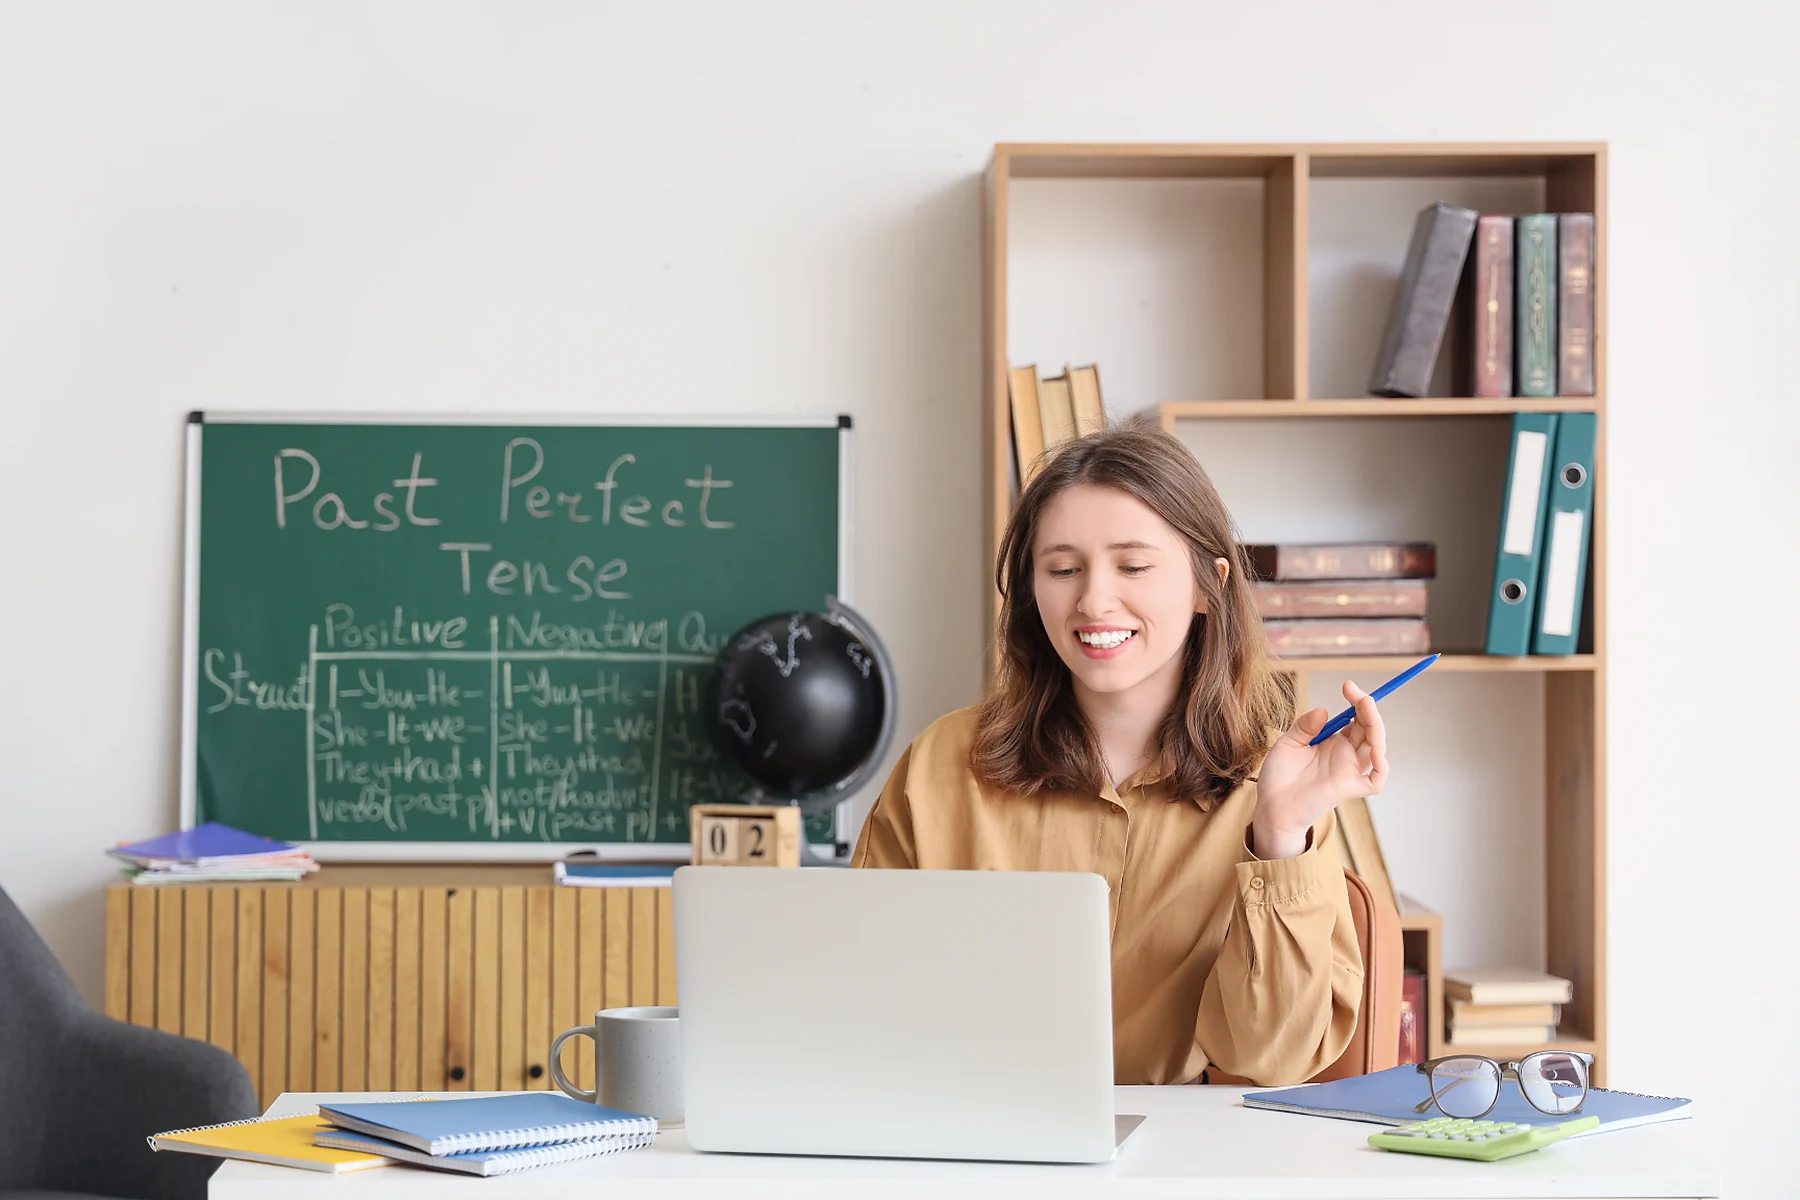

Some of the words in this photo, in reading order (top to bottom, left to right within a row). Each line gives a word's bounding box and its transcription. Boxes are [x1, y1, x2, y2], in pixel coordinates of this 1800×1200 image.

[274, 448, 442, 532] Past
[500, 436, 736, 529] Perfect
[439, 542, 633, 602] Tense
[325, 602, 468, 649] Positive
[506, 607, 664, 653] Negative
